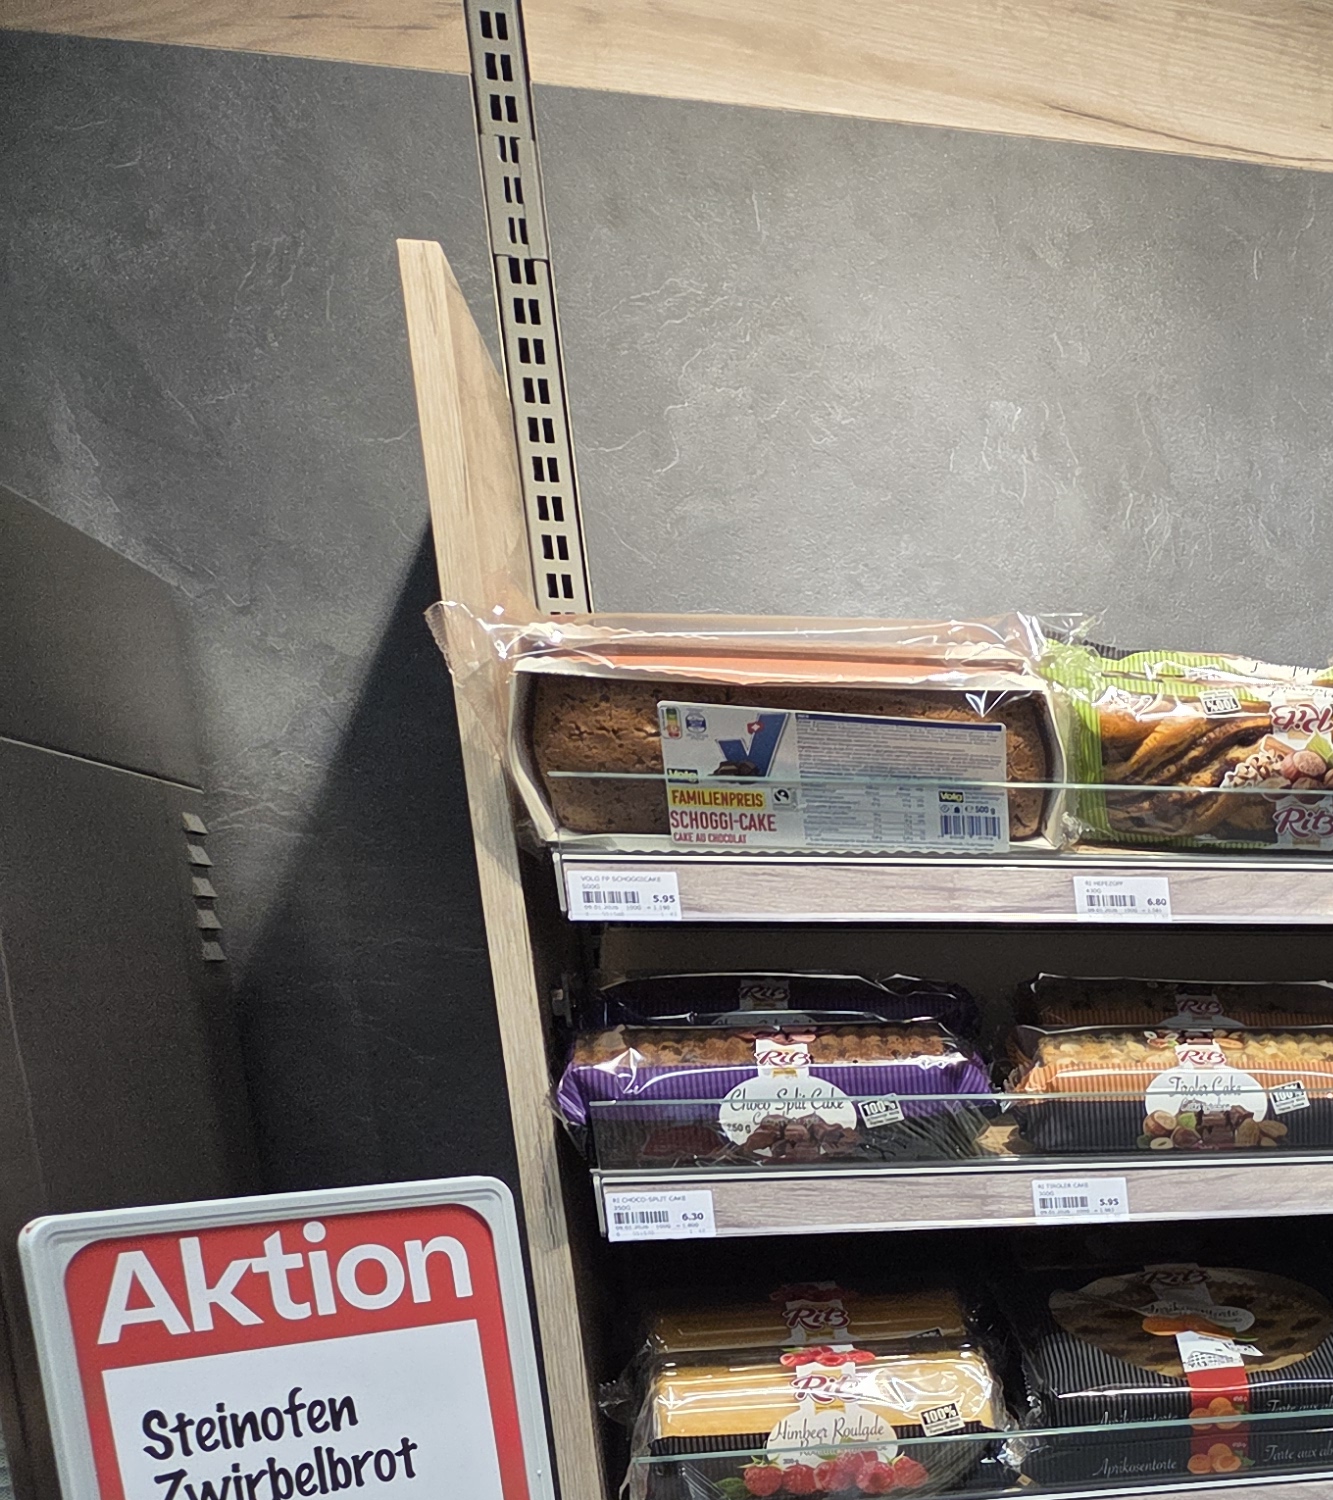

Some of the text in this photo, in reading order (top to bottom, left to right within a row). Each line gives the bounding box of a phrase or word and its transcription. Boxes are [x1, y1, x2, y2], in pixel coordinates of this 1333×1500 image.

[671, 790, 763, 807] FAMILIENPREIS
[940, 792, 963, 802] Volg
[670, 811, 777, 831] SCHOGGI-CAKE
[653, 895, 675, 903] 5.95
[1147, 898, 1167, 906] 6.80
[731, 1087, 844, 1114] Choco Split Cake
[682, 1212, 703, 1220] 6.30
[97, 1221, 474, 1346] Aktion
[142, 1386, 358, 1461] Steinofen
[923, 1405, 958, 1423] 100%
[769, 1415, 884, 1442] Himbeer Roulade
[1092, 1458, 1177, 1476] Aprikosentorte
[1262, 1445, 1293, 1462] Tarte
